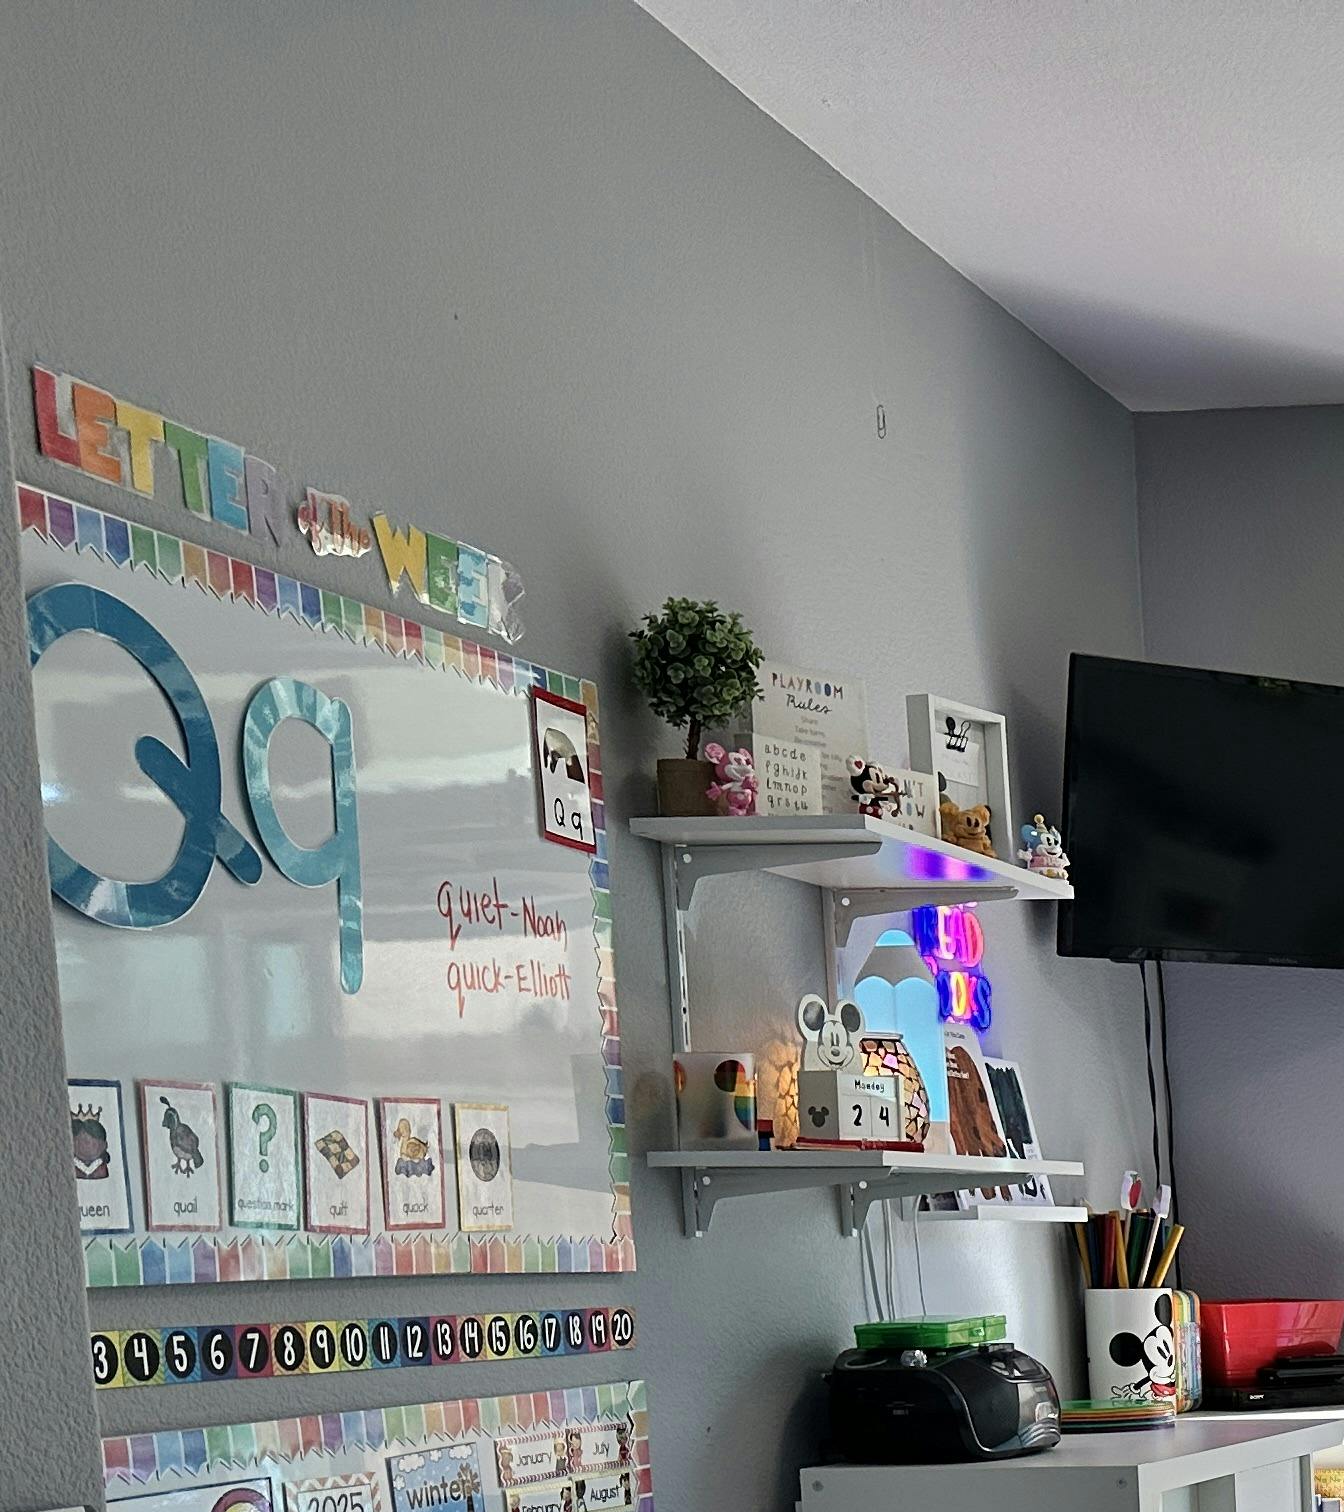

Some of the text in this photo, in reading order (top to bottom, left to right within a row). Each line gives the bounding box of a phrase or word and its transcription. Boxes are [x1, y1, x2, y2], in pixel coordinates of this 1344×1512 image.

[34, 366, 286, 548] LETTER
[771, 672, 844, 700] PLAYROOM
[786, 693, 833, 715] Rules
[853, 1079, 886, 1094] Monday
[172, 1197, 198, 1217] quail
[471, 1203, 505, 1217] quarter
[94, 1310, 633, 1379] 3 4 5 6 7 8 9 10 11 12 13 14 15 16 17 18 19 20
[516, 1451, 553, 1467] January
[592, 1441, 611, 1458] July
[405, 1481, 470, 1512] winter
[590, 1484, 620, 1504] August
